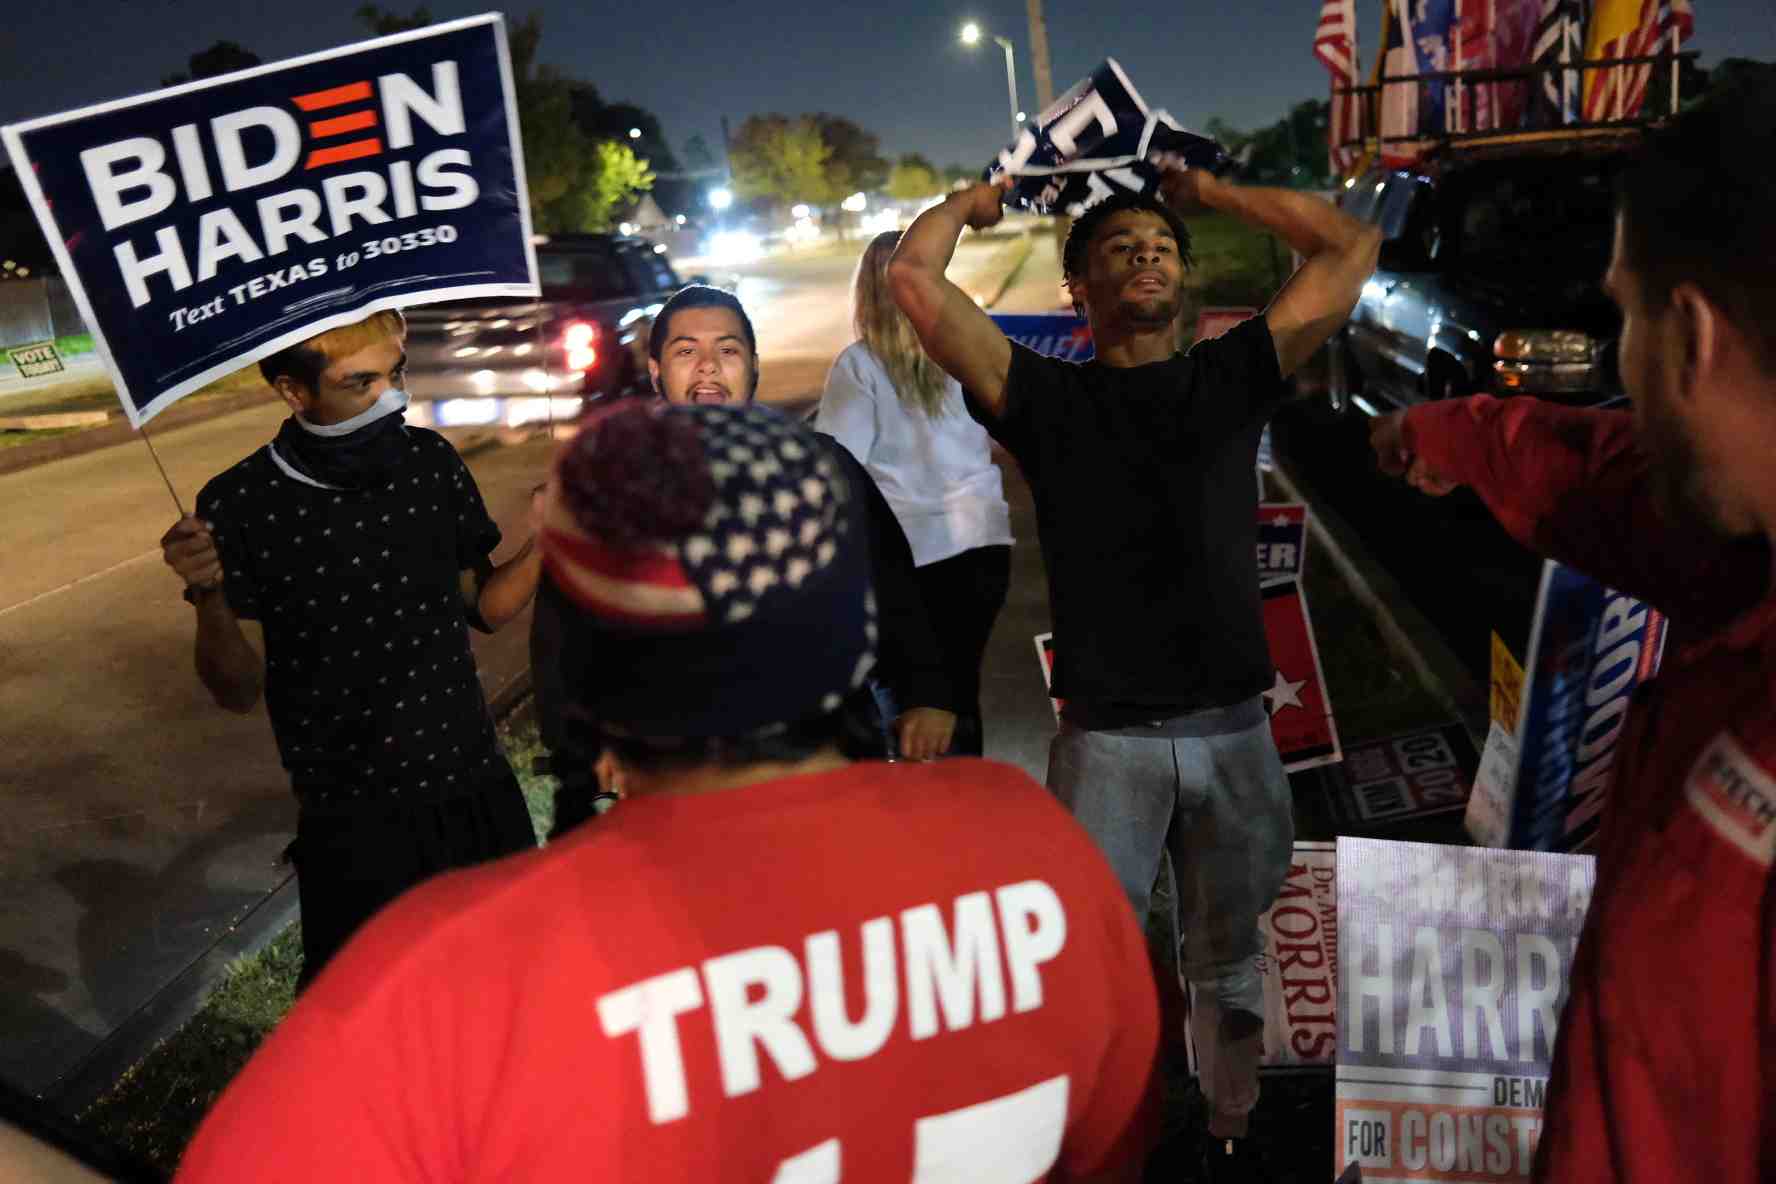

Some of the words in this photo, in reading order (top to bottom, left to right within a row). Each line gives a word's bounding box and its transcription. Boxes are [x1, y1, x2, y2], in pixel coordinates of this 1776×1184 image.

[80, 60, 467, 232] BIDEN
[113, 149, 480, 308] HARRIS
[169, 294, 226, 332] Text
[228, 257, 328, 305] TEXAS
[336, 251, 360, 271] to
[363, 224, 457, 260] 30330
[1564, 588, 1649, 833] MOOR
[1309, 865, 1335, 896] Dr.
[595, 879, 1068, 1125] TRUMP
[1271, 863, 1336, 1060] MORRIS
[1348, 919, 1565, 1063] HARR
[1349, 1119, 1387, 1157] FOR
[1402, 1110, 1545, 1176] CONST
[1493, 1076, 1548, 1108] DEM
